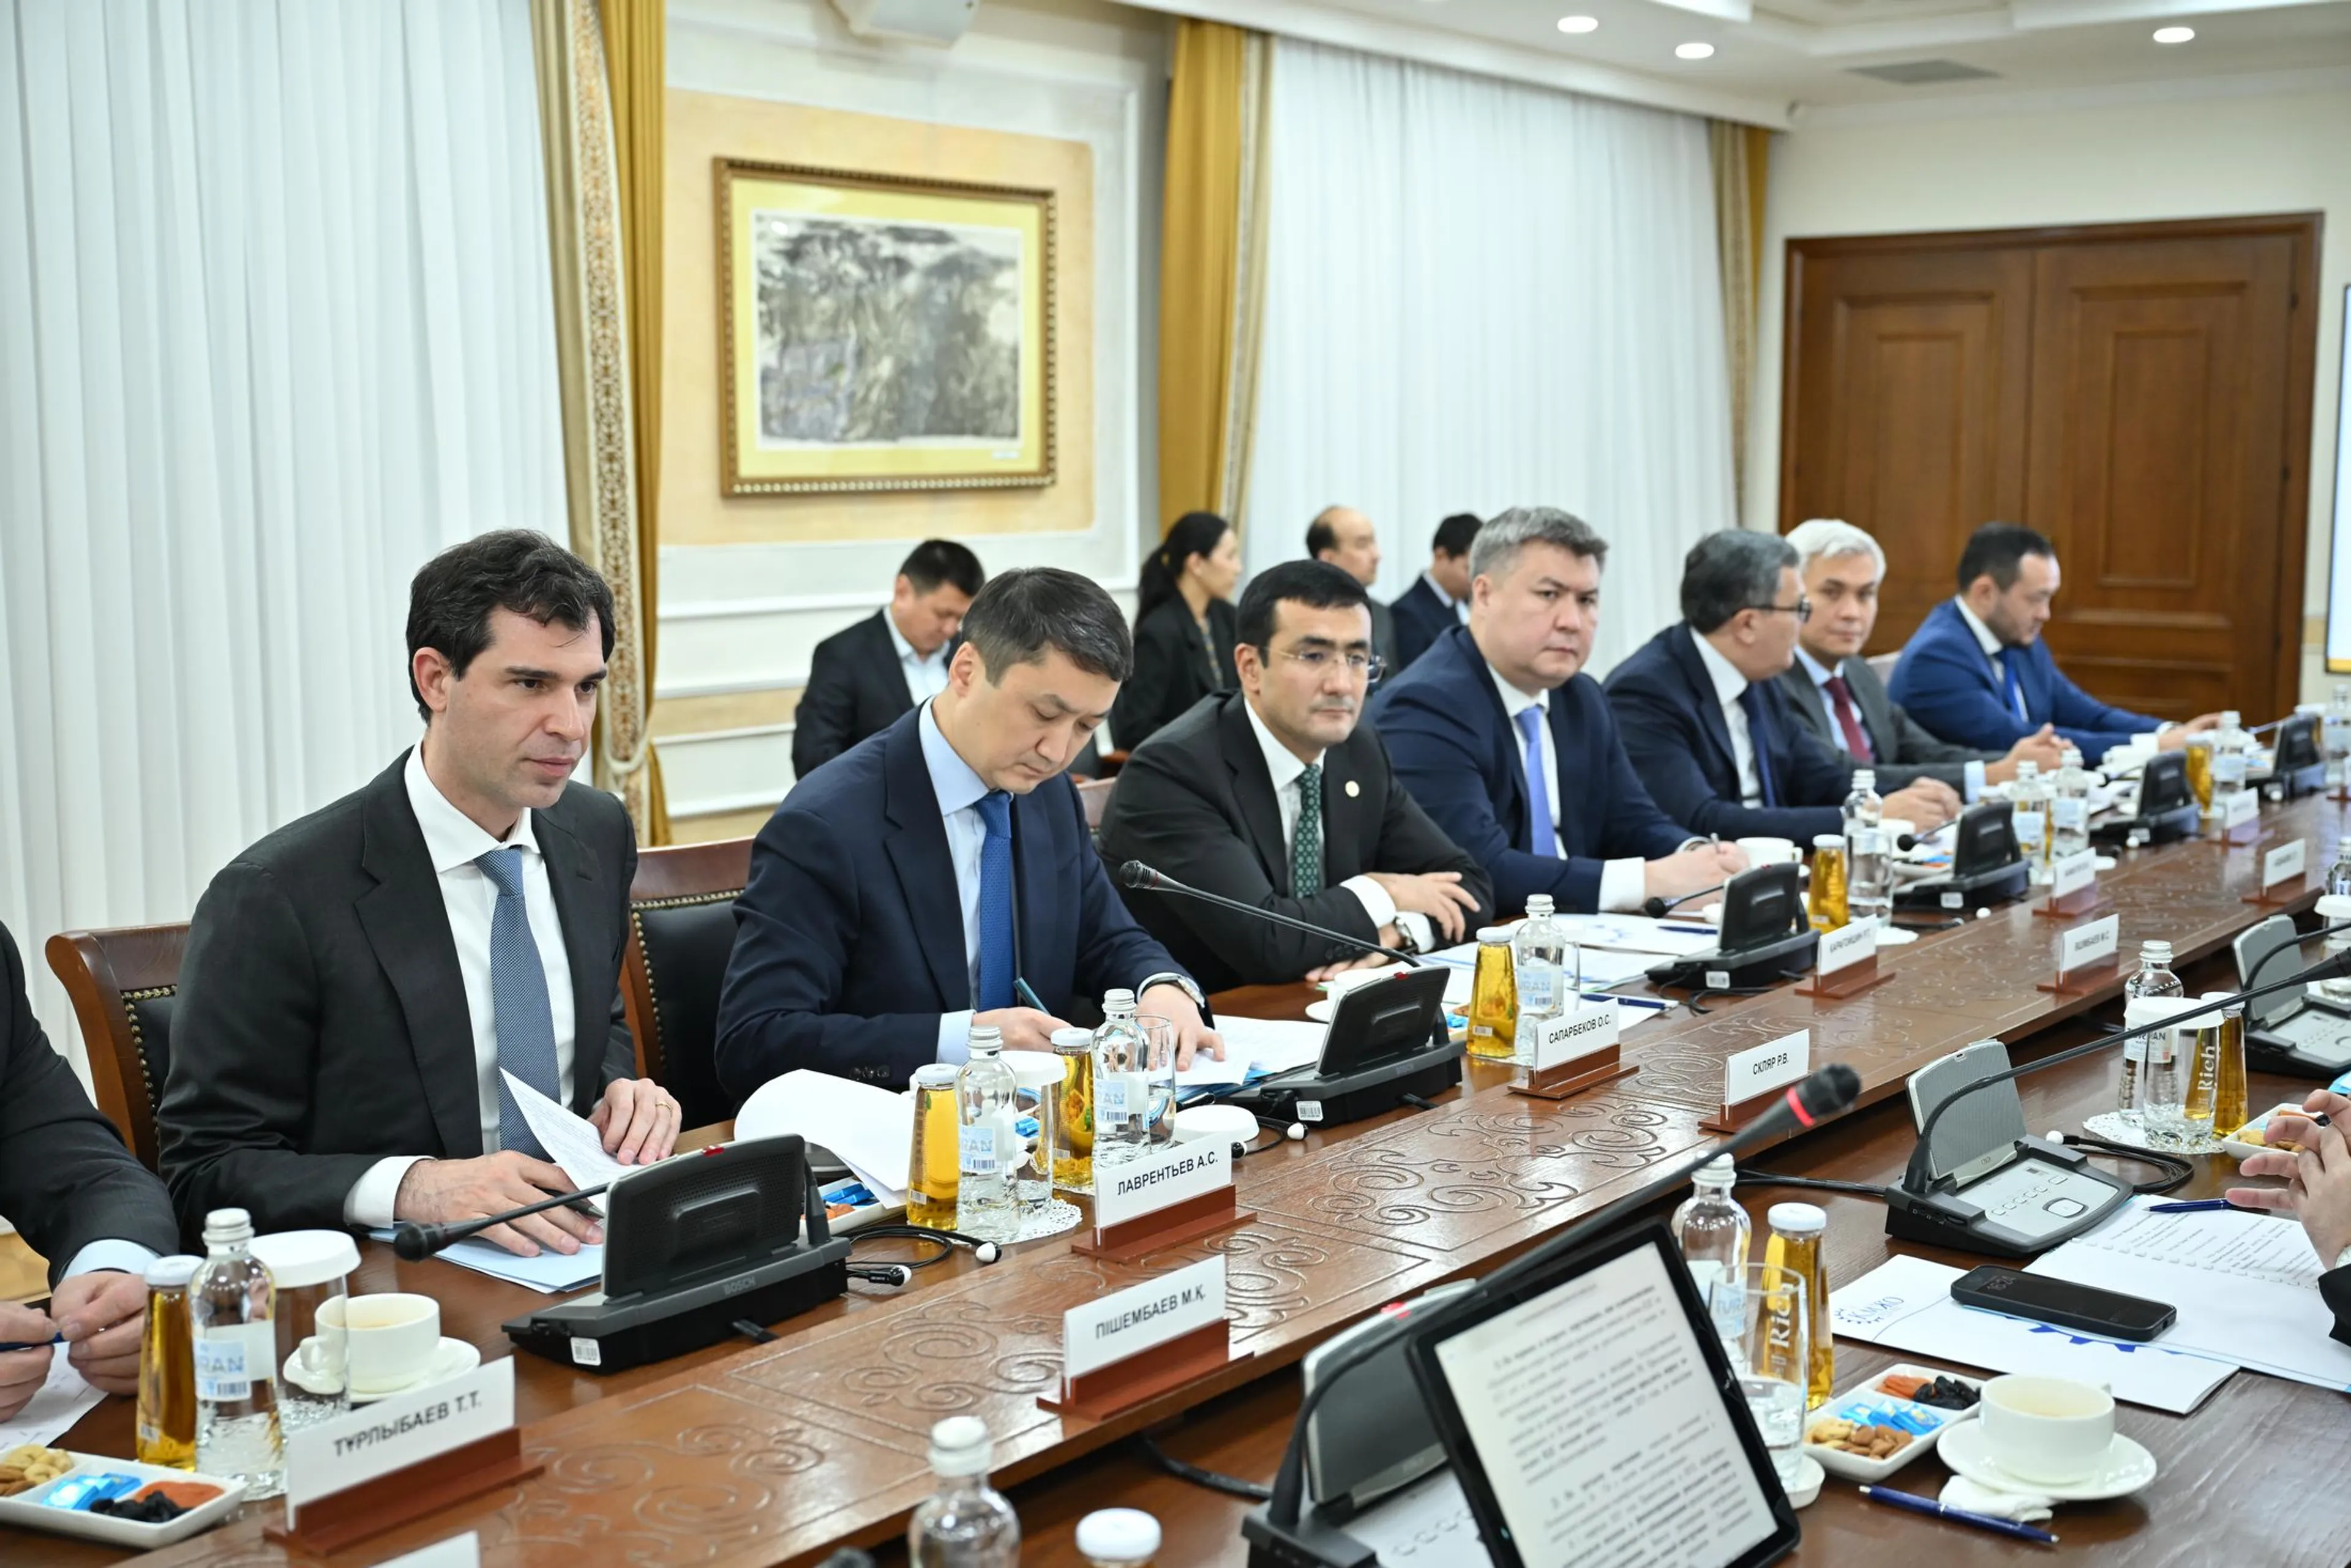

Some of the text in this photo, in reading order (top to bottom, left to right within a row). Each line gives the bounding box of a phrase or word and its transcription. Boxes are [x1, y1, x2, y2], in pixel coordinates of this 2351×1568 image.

[1548, 1014, 1611, 1044] САПАРБЕКОВ О.С.
[1752, 1057, 1776, 1075] СКЛЯР
[2197, 1046, 2215, 1090] Rich
[1117, 1152, 1218, 1195] ЛАВРЕНТЬЕВ А.С.
[1095, 1294, 1178, 1340] ПІШЕМБАЕВ
[333, 1390, 482, 1457] ТҰРЛЫБАЕВ Т.Т.
